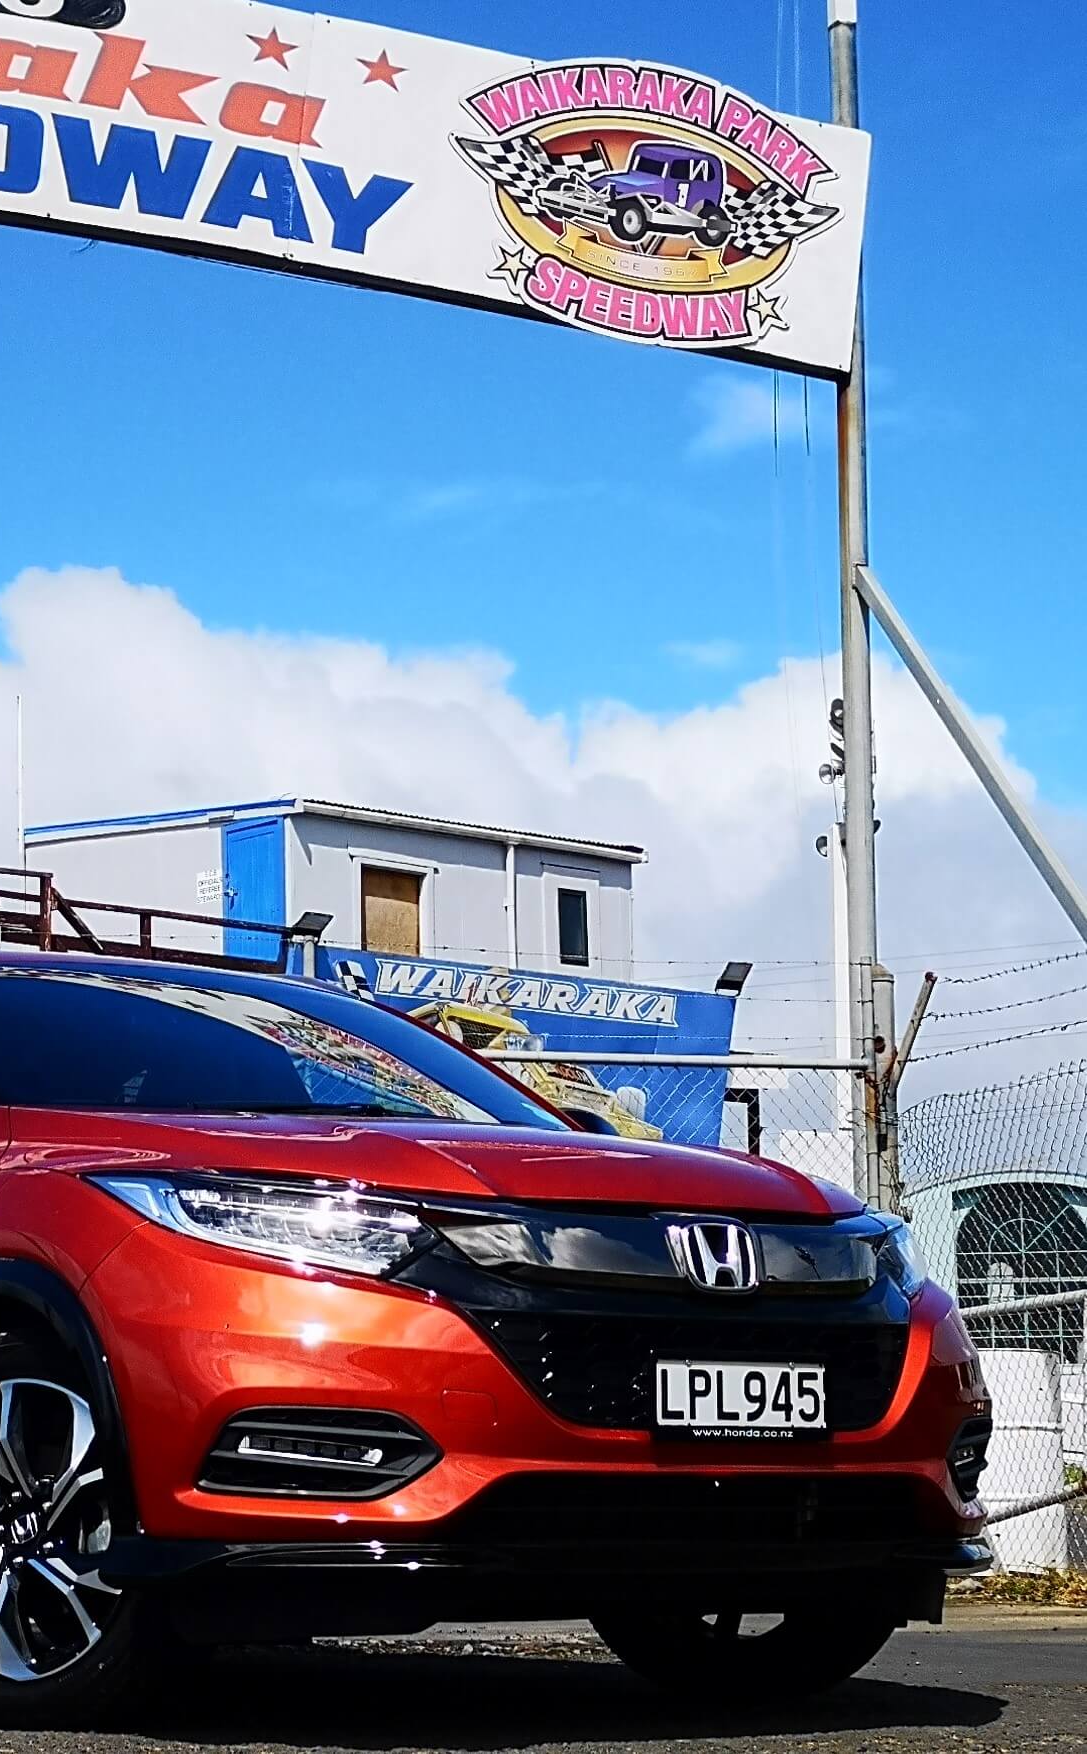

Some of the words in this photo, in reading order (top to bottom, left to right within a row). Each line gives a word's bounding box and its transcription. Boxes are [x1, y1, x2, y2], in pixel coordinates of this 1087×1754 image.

[472, 66, 715, 133] WAIKARAKA
[719, 94, 833, 192] PARK
[586, 248, 642, 272] SINCE
[526, 256, 749, 340] SPEEDWAY
[376, 960, 677, 1025] WAIKARAKA
[660, 1368, 821, 1423] LPL945
[692, 1428, 794, 1438] www.honda.co.nz
